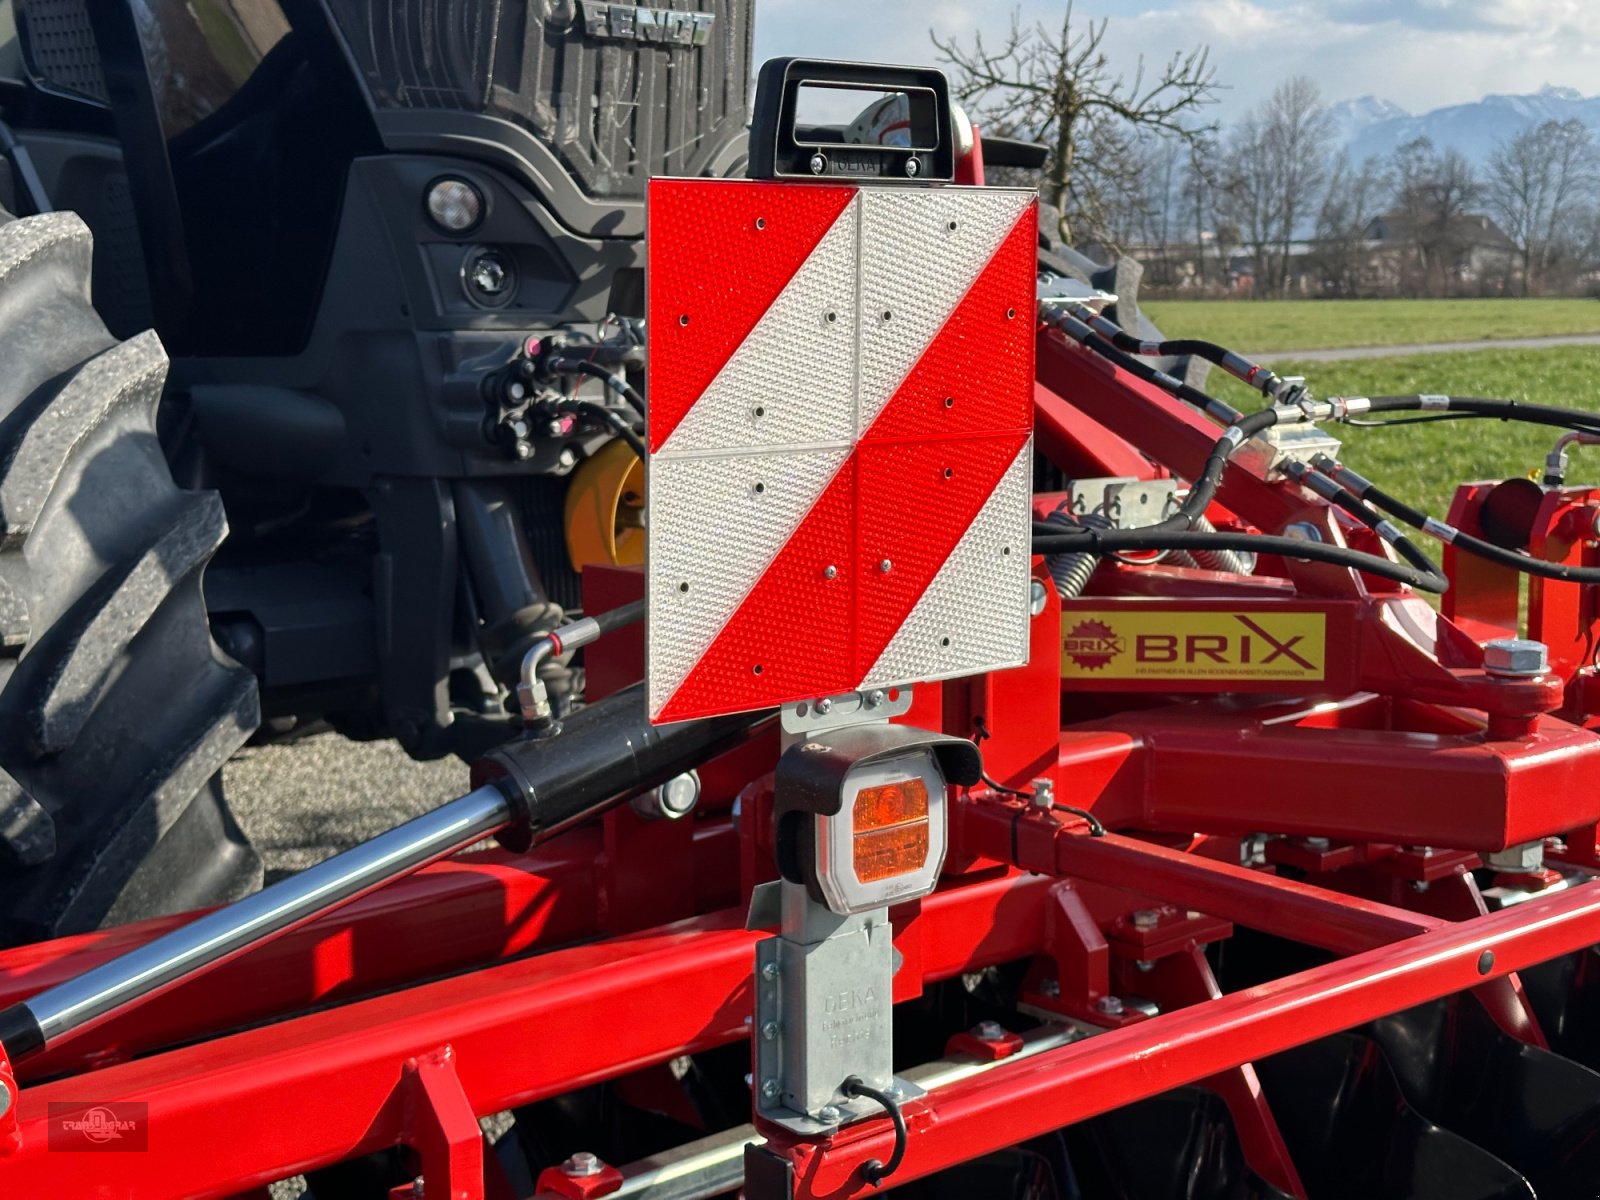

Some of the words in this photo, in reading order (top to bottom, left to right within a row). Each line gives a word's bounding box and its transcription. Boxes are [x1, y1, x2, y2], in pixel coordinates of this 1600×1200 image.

[582, 1, 716, 45] FENDT
[1064, 636, 1123, 653] BRIX
[1136, 615, 1318, 670] BRIX
